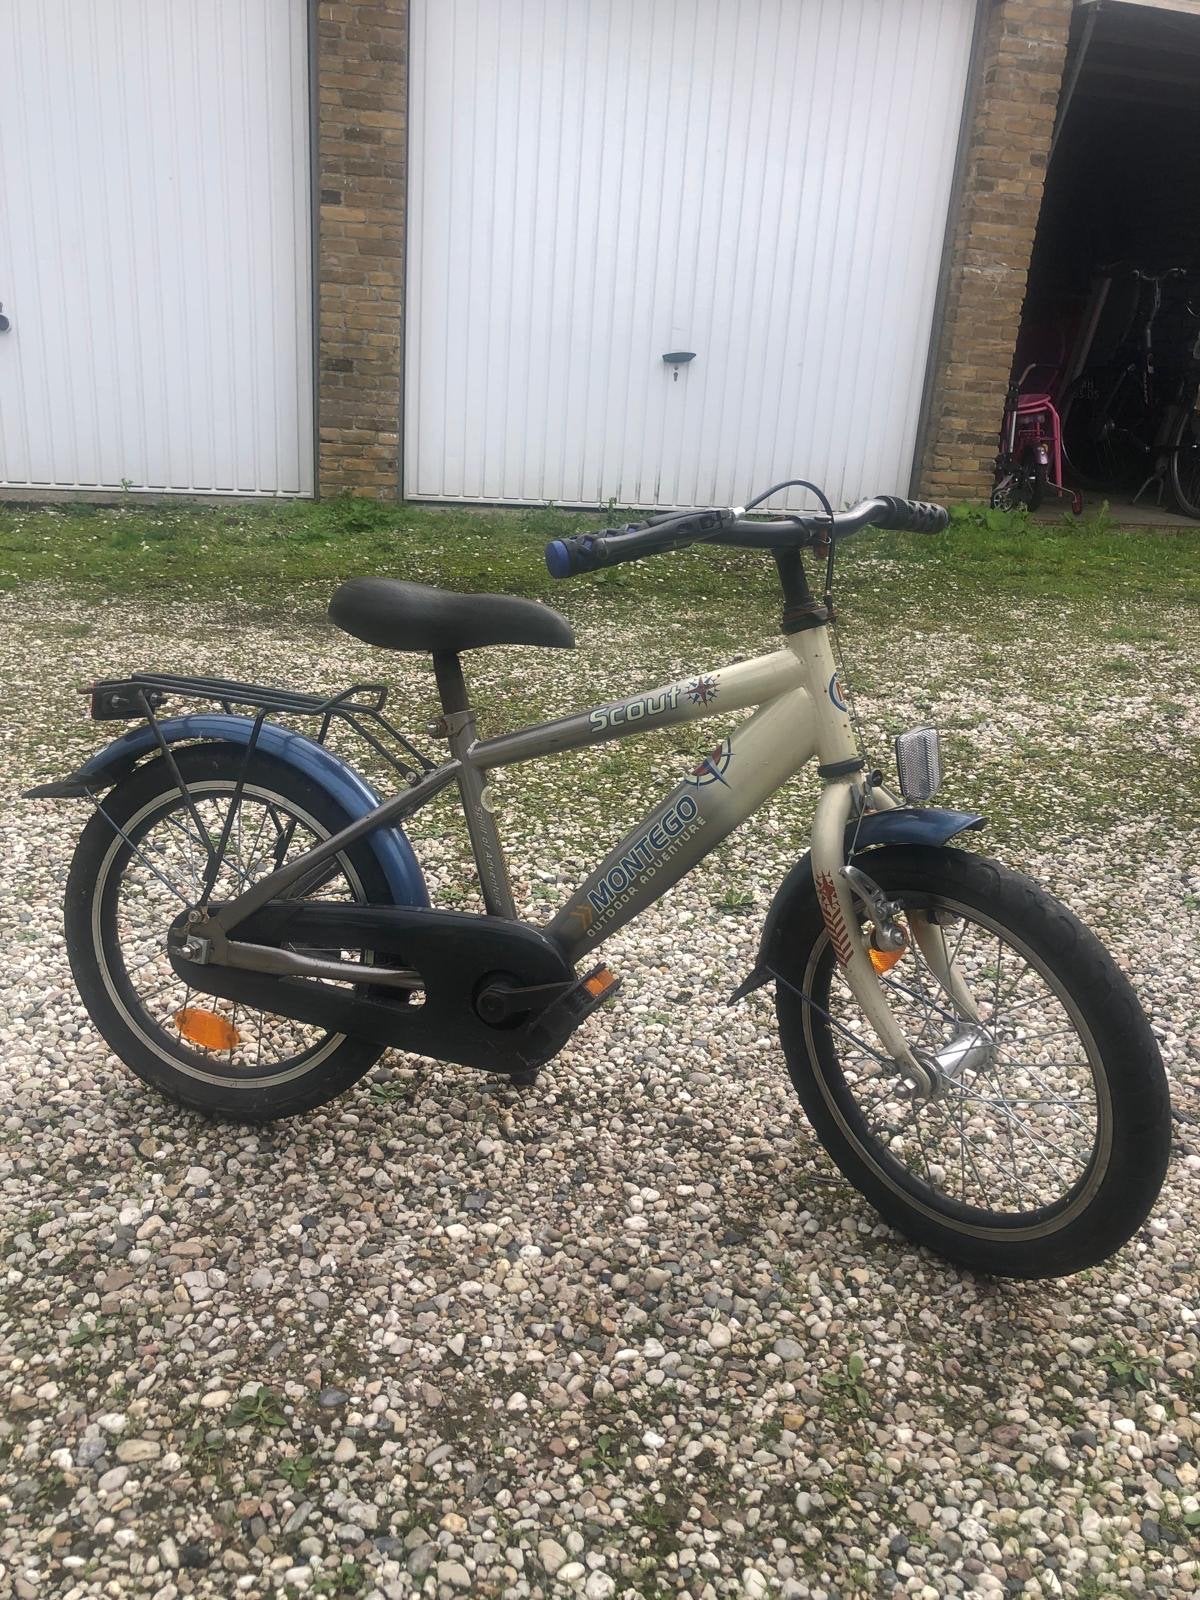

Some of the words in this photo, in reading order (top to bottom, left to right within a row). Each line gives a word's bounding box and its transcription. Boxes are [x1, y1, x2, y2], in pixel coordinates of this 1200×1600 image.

[586, 794, 698, 914] MONTEGO
[586, 887, 638, 938] OUTDOOR
[639, 816, 707, 885] ADVENTURE
